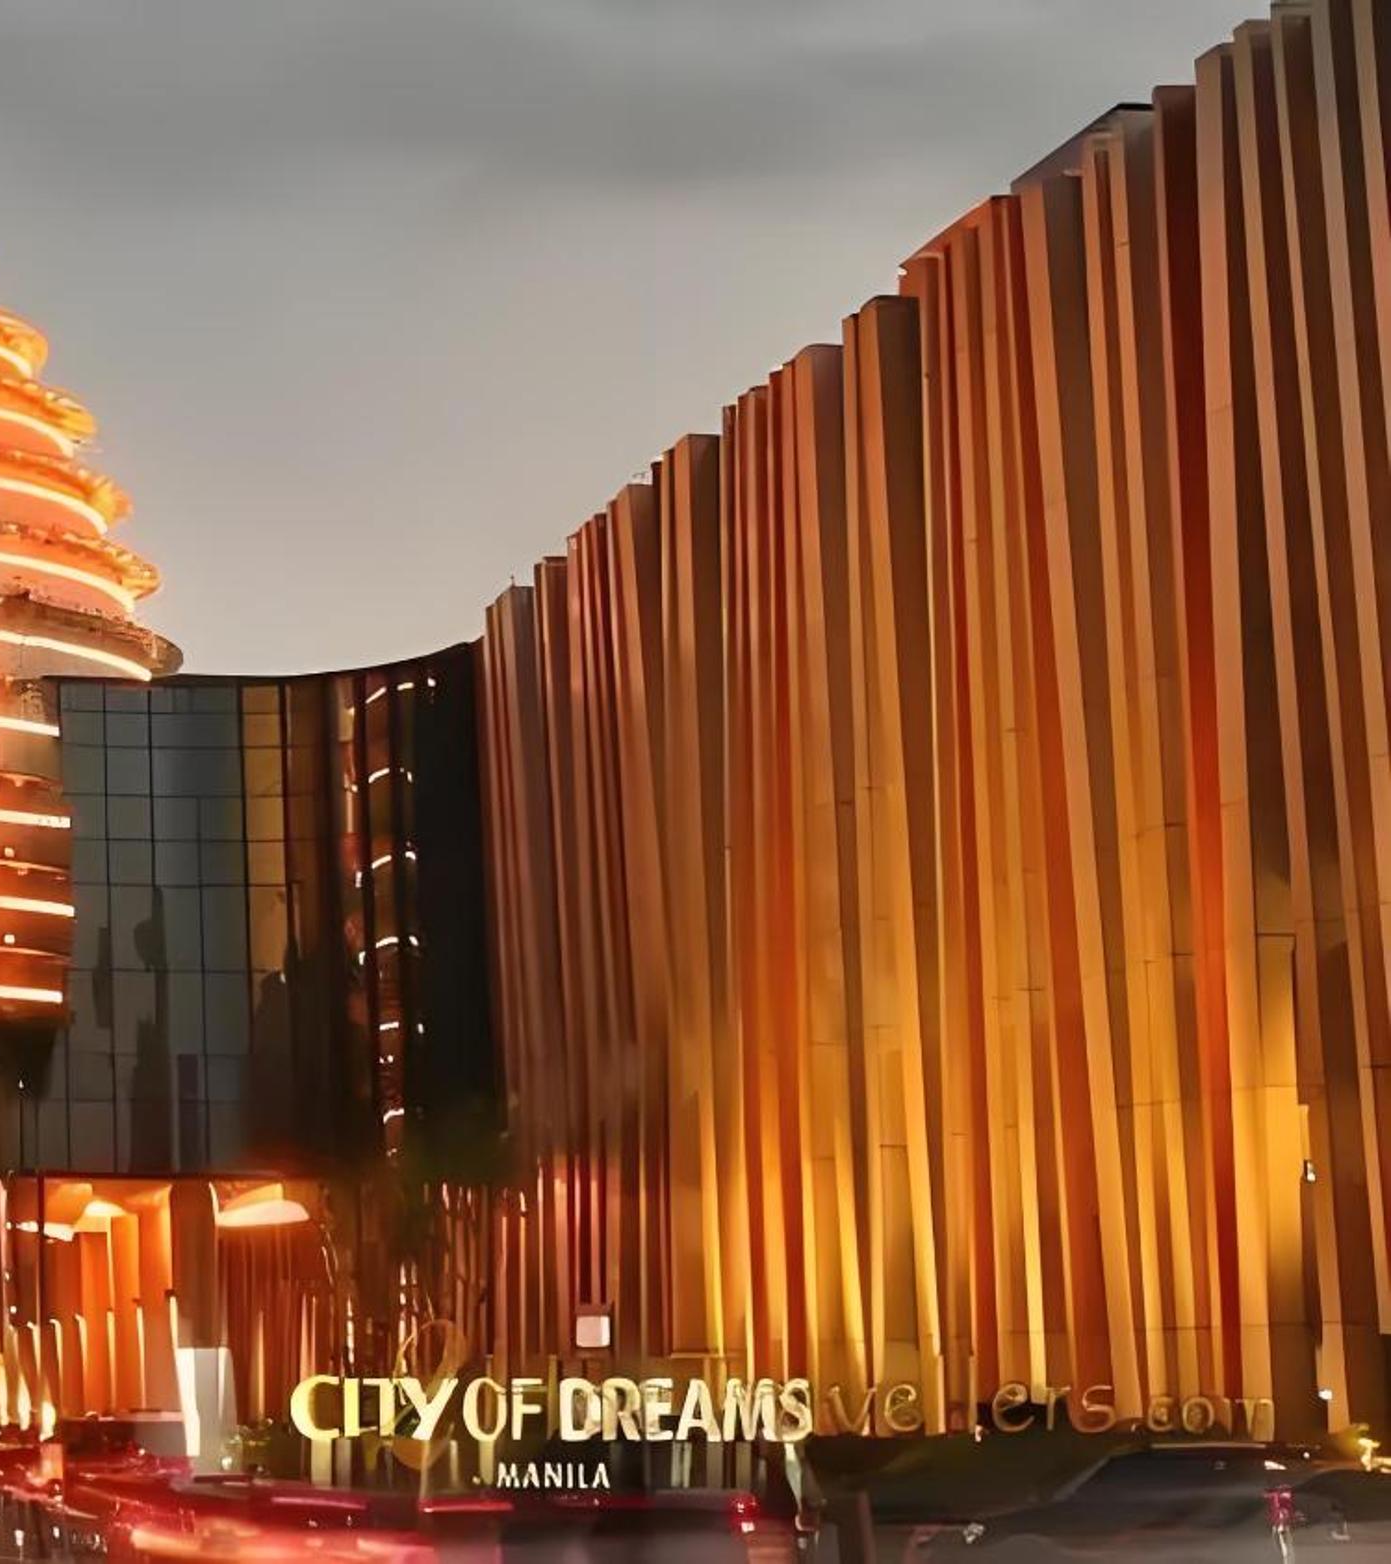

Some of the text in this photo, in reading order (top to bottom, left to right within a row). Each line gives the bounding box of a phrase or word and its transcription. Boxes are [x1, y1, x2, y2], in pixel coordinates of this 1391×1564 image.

[290, 1375, 459, 1441] CITY
[463, 1377, 543, 1441] OF
[559, 1377, 813, 1442] DREAMS
[497, 1462, 610, 1490] MANILA
